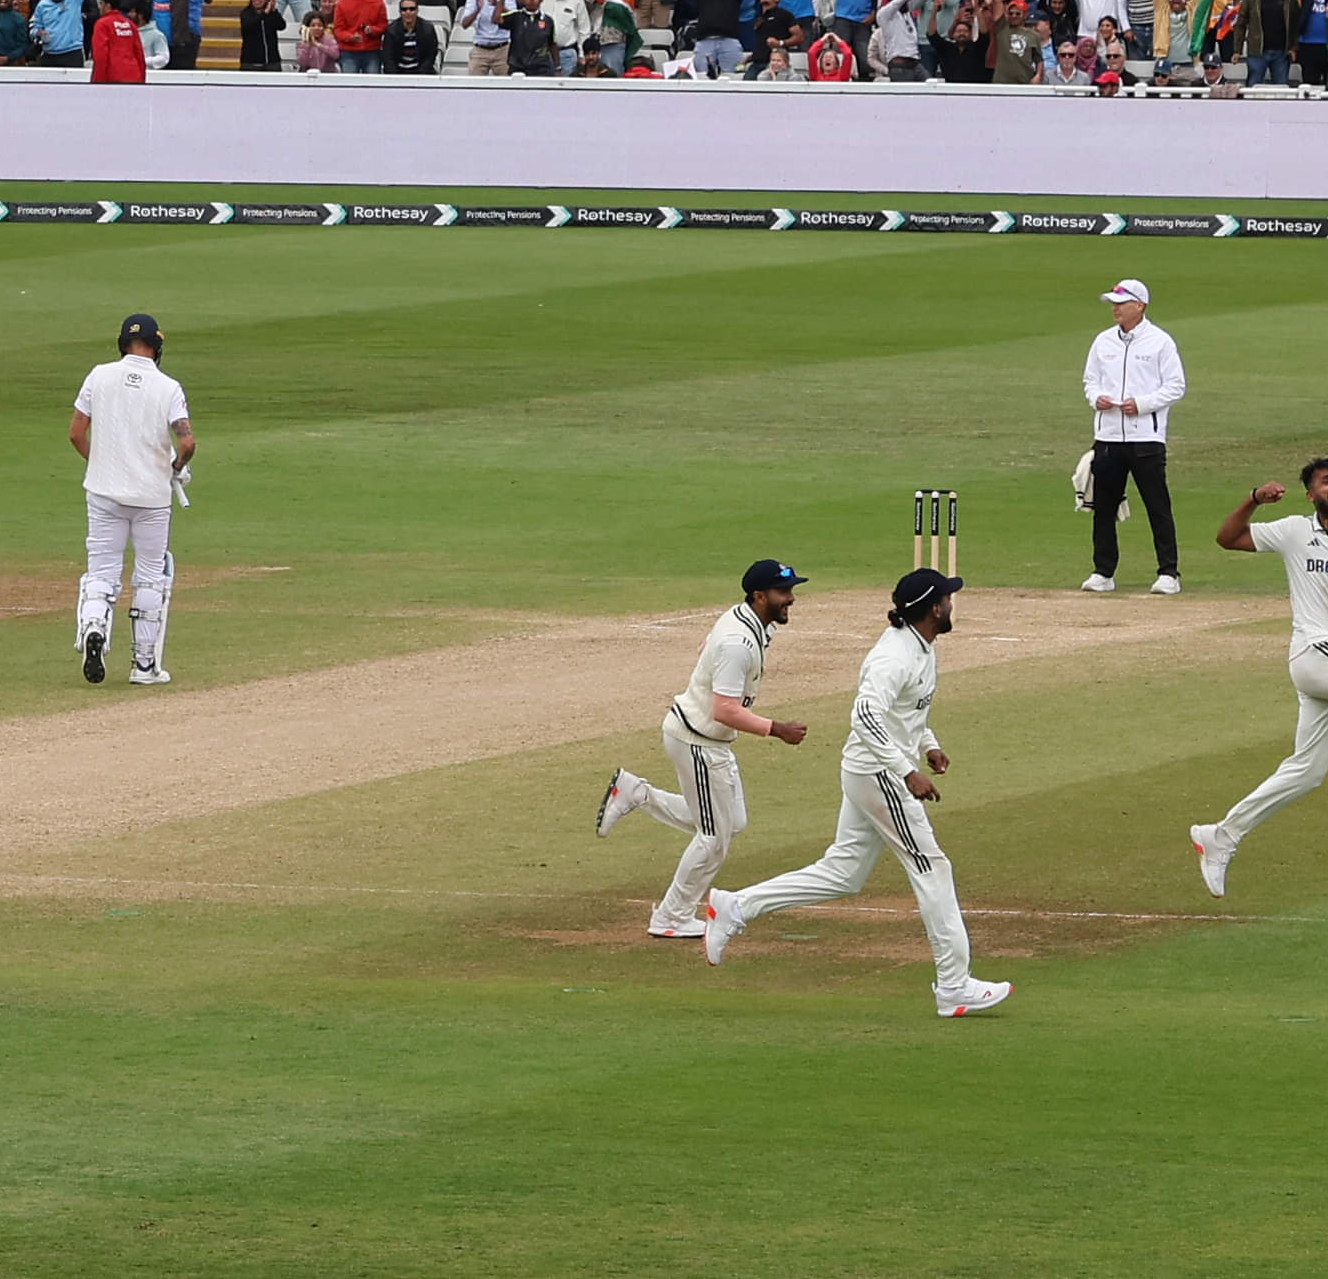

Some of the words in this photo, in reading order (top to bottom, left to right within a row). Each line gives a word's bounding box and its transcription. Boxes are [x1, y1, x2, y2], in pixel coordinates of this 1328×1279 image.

[17, 206, 57, 217] Protecting
[58, 206, 92, 217] Pensions
[131, 205, 205, 220] Rothesay
[243, 208, 282, 219] Protecting
[283, 208, 318, 219] Pensions
[354, 206, 428, 222] Rothesay
[466, 211, 506, 220] Protecting
[507, 211, 541, 220] Pensions
[578, 209, 652, 224] Rothesay
[691, 213, 730, 223] Protecting
[731, 213, 765, 223] Pensions
[801, 212, 874, 226] Rothesay
[910, 215, 950, 225] Protecting
[951, 215, 984, 225] Pensions
[1023, 215, 1096, 231] Rothesay
[1134, 218, 1174, 229] Protecting
[1175, 218, 1209, 229] Pensions
[1247, 219, 1321, 235] Rothesay
